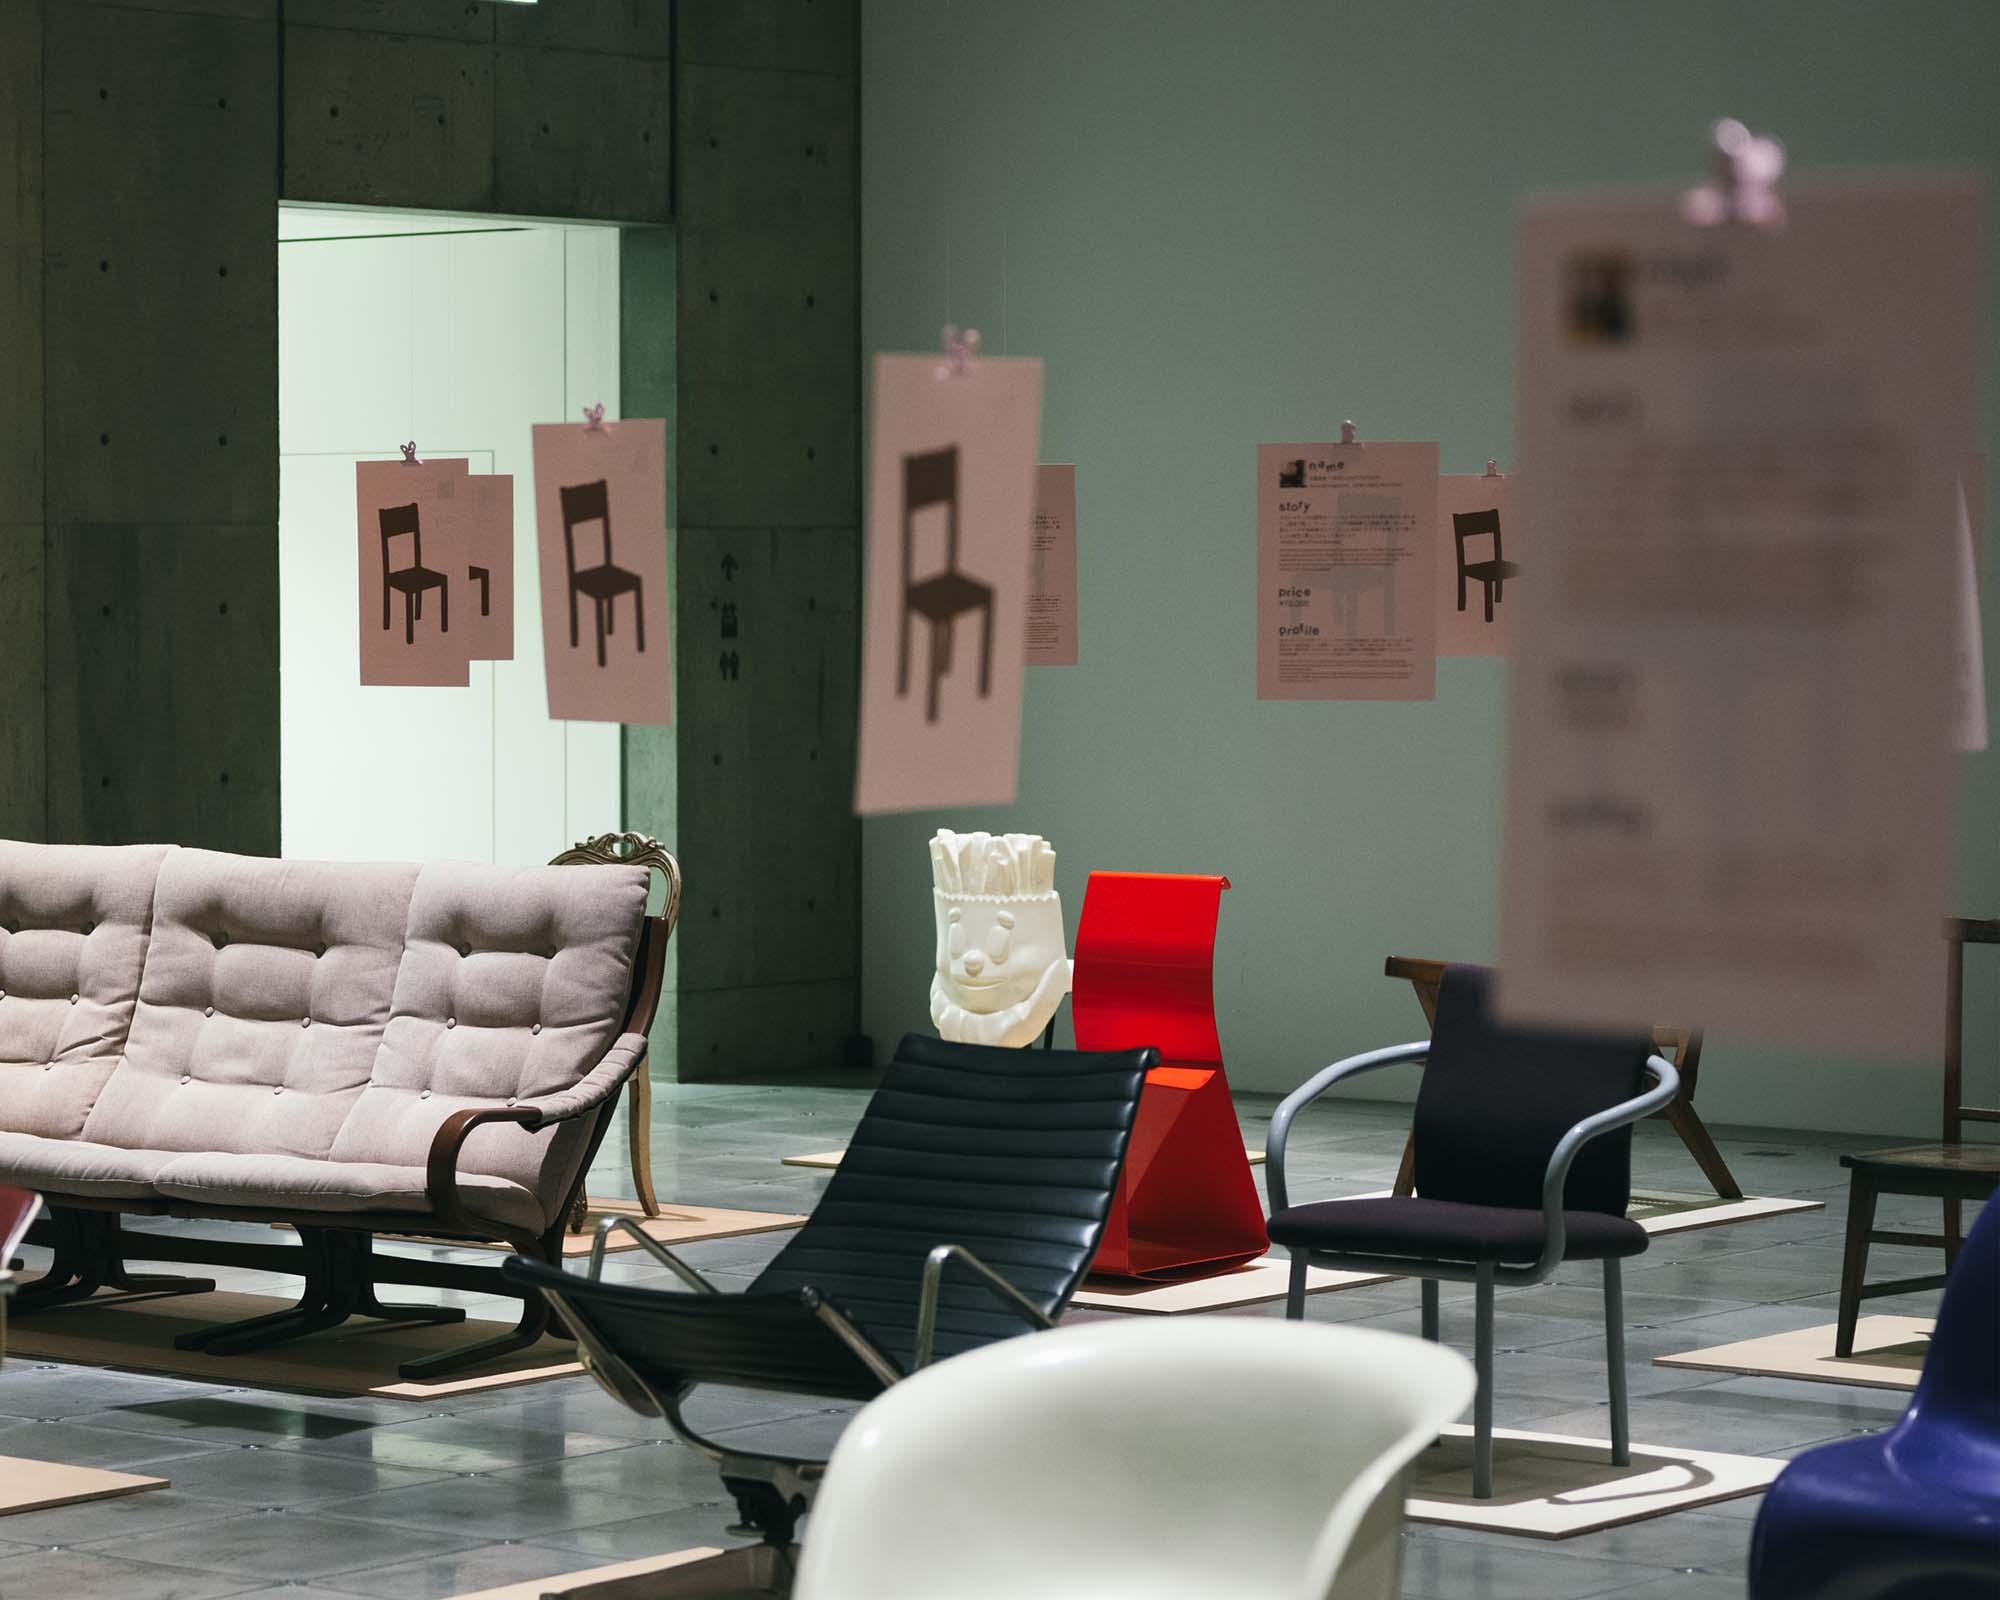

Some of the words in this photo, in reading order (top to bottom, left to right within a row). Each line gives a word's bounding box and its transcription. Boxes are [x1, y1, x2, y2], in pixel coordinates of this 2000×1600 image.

[1309, 461, 1345, 472] name
[1279, 501, 1311, 513] story
[1279, 586, 1311, 598] price
[1279, 623, 1320, 637] profile
